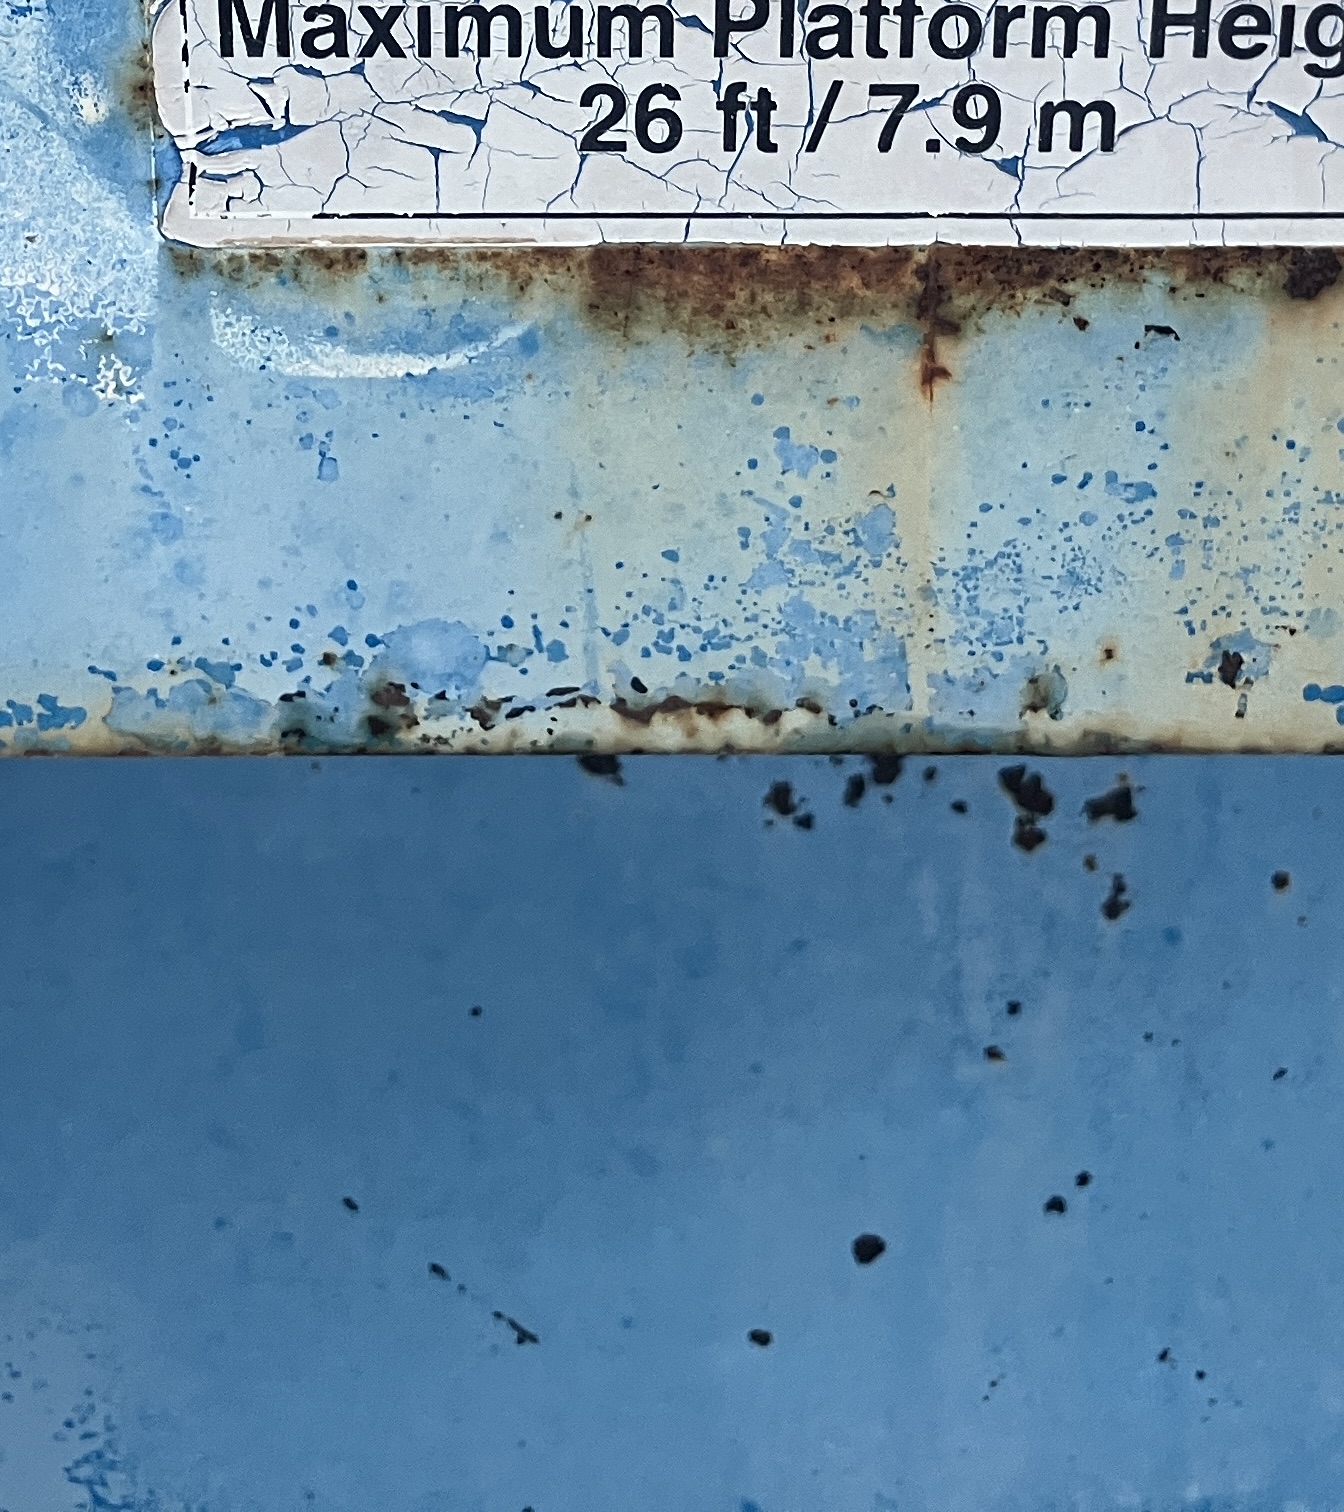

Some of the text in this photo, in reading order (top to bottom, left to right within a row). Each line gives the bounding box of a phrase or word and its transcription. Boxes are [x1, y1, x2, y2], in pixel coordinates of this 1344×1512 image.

[577, 80, 1115, 153] 26 ft / 7.9 m
